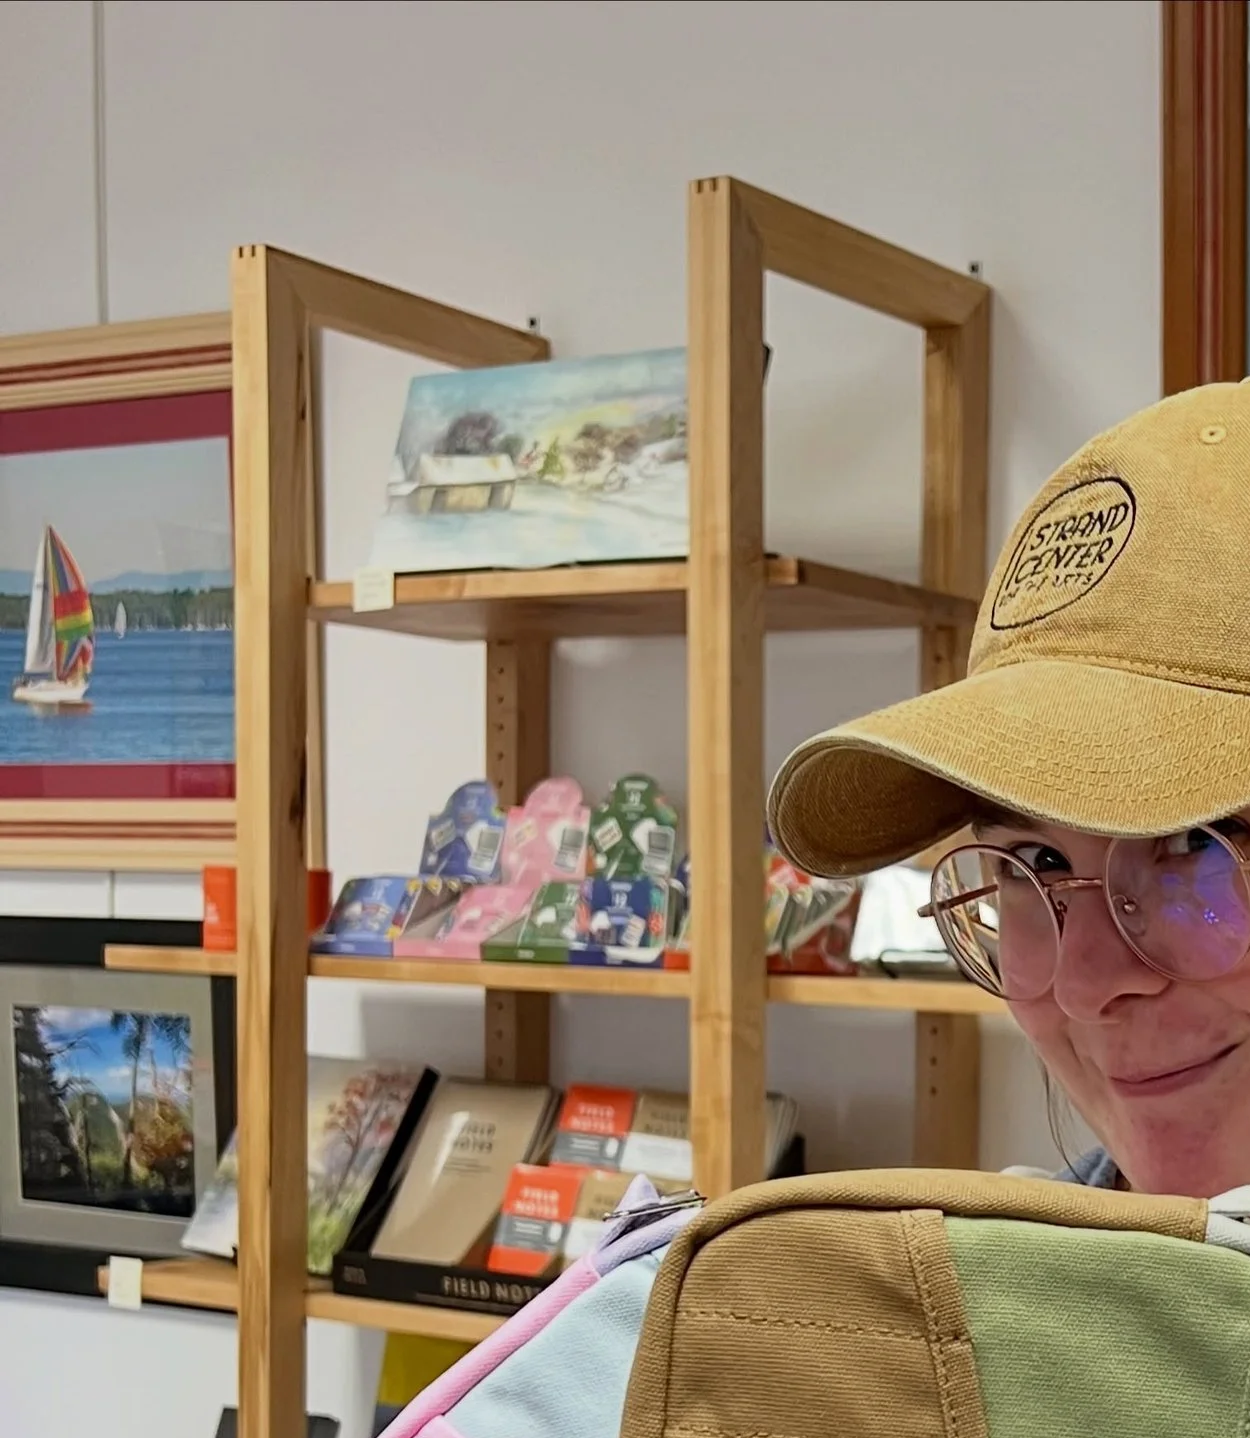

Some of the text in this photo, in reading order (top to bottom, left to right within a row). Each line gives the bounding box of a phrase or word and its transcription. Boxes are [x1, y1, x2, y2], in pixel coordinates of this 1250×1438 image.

[1030, 501, 1130, 551] STRAND
[1014, 536, 1114, 584] CENTER
[577, 1103, 615, 1119] FIELD
[460, 1120, 497, 1138] FIELD
[568, 1116, 615, 1134] NOTES
[520, 1186, 560, 1203] FIELD
[512, 1200, 559, 1220] NOTES
[443, 1275, 540, 1304] FIELD NOT
